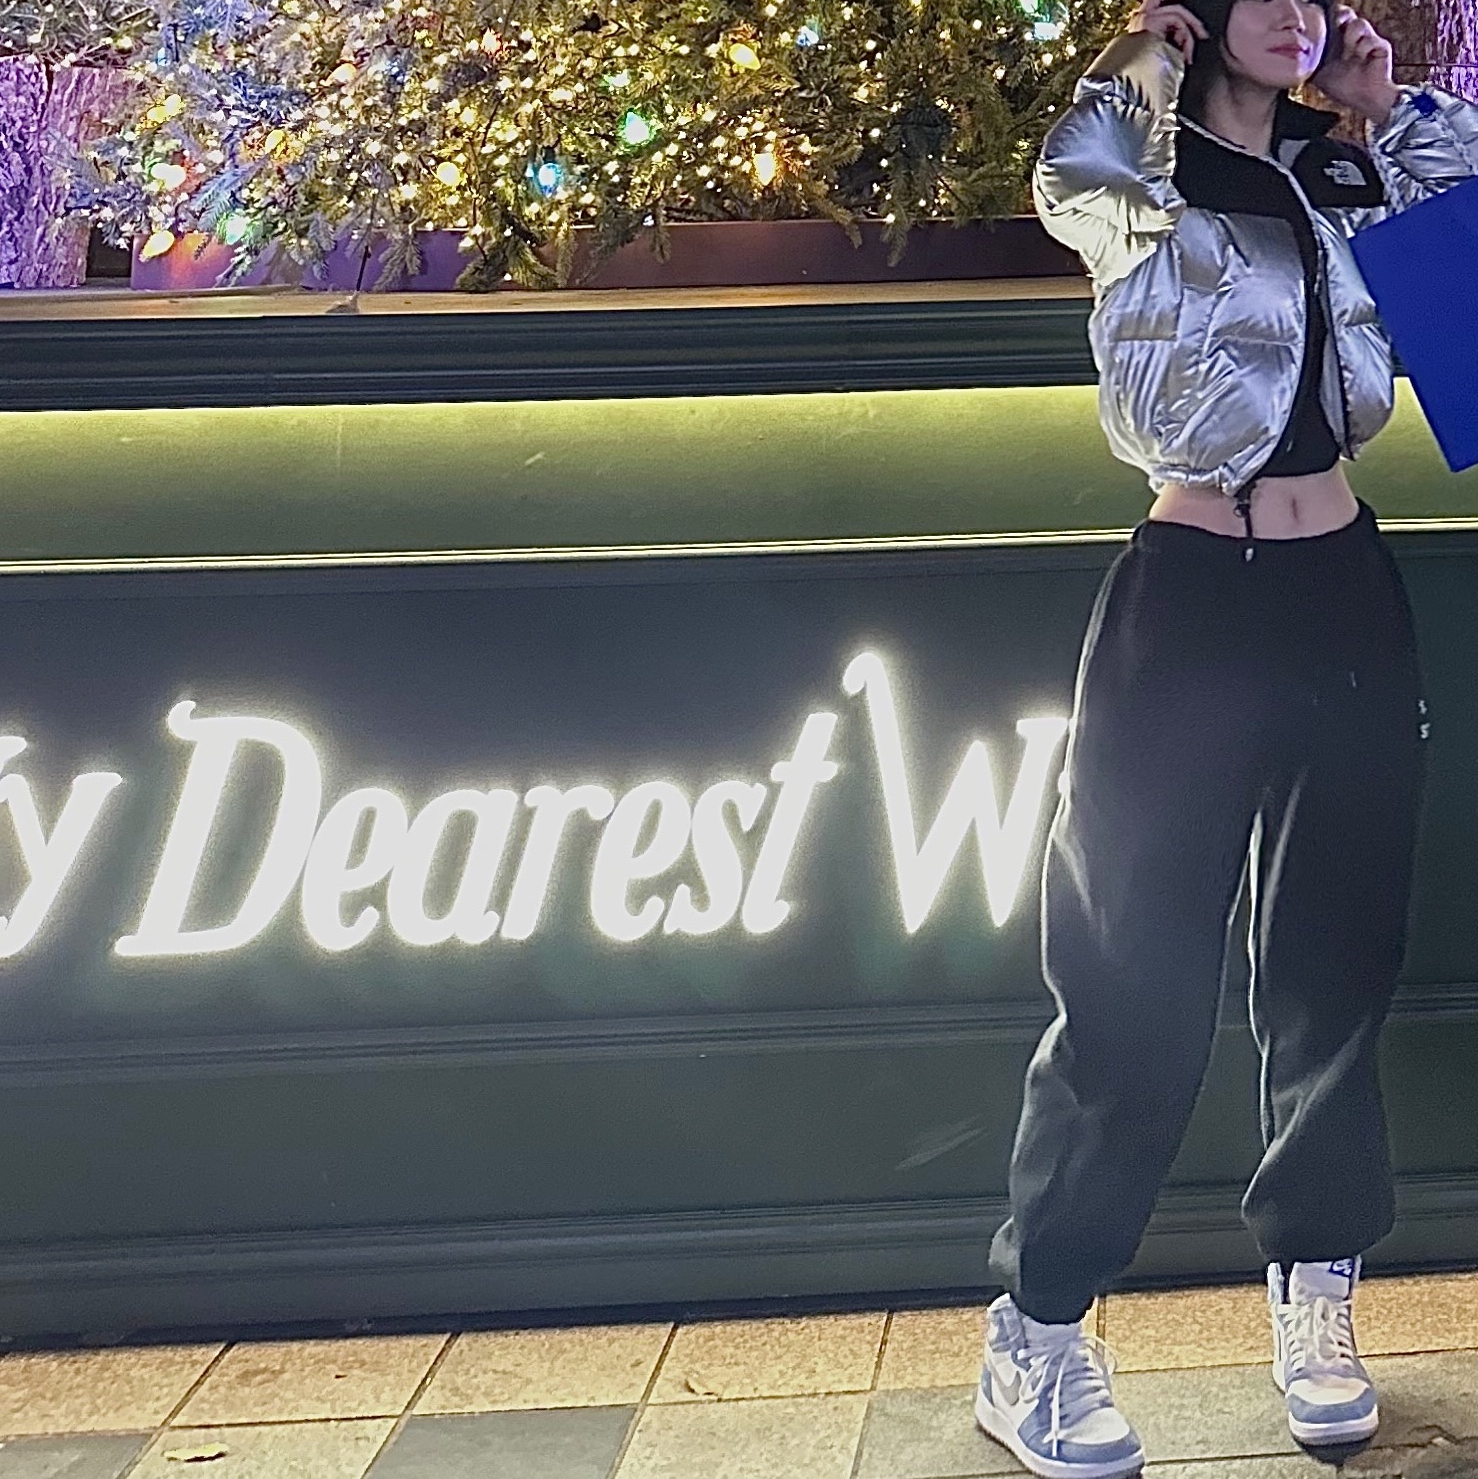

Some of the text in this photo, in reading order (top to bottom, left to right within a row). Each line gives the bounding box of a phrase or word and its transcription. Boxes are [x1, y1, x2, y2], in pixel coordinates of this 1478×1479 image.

[0, 650, 1070, 958] y Dearest W
